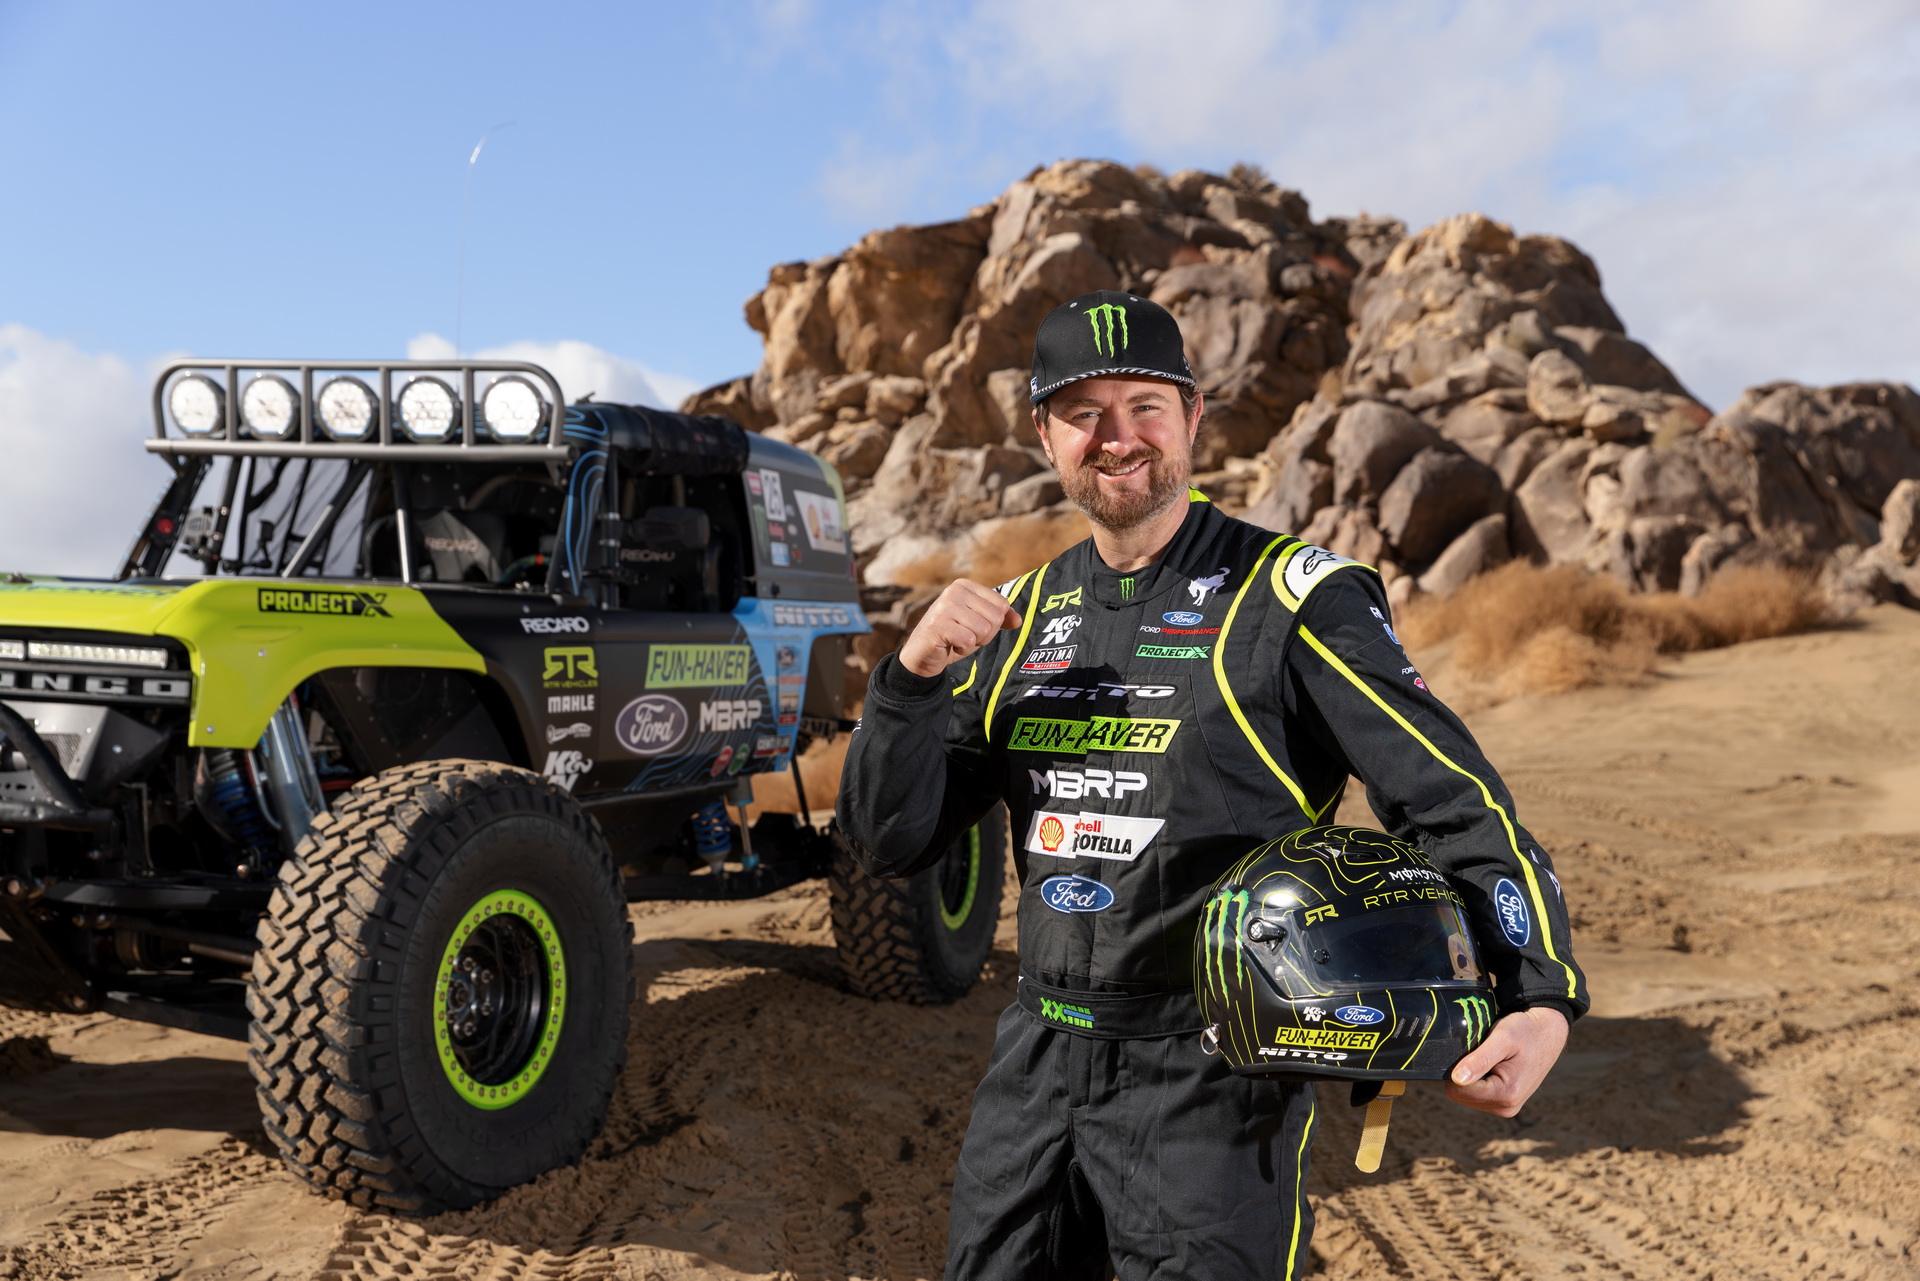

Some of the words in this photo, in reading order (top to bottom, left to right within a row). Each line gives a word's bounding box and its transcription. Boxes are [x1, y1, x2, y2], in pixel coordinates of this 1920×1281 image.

[520, 617, 590, 633] RECARO
[1140, 625, 1160, 633] FORD
[1161, 627, 1220, 635] PERFORMANCE
[1029, 649, 1073, 662] OPTIMA
[650, 650, 747, 682] FUN-HAVER
[548, 695, 595, 713] MAHLE
[630, 702, 676, 745] Ford
[700, 699, 763, 733] MBRP
[1028, 768, 1148, 800] MBRP
[1363, 890, 1409, 910] RTR
[1499, 893, 1525, 935] Ford
[1277, 1028, 1376, 1048] FUN-HAVER
[1258, 1047, 1348, 1061] NITTO
